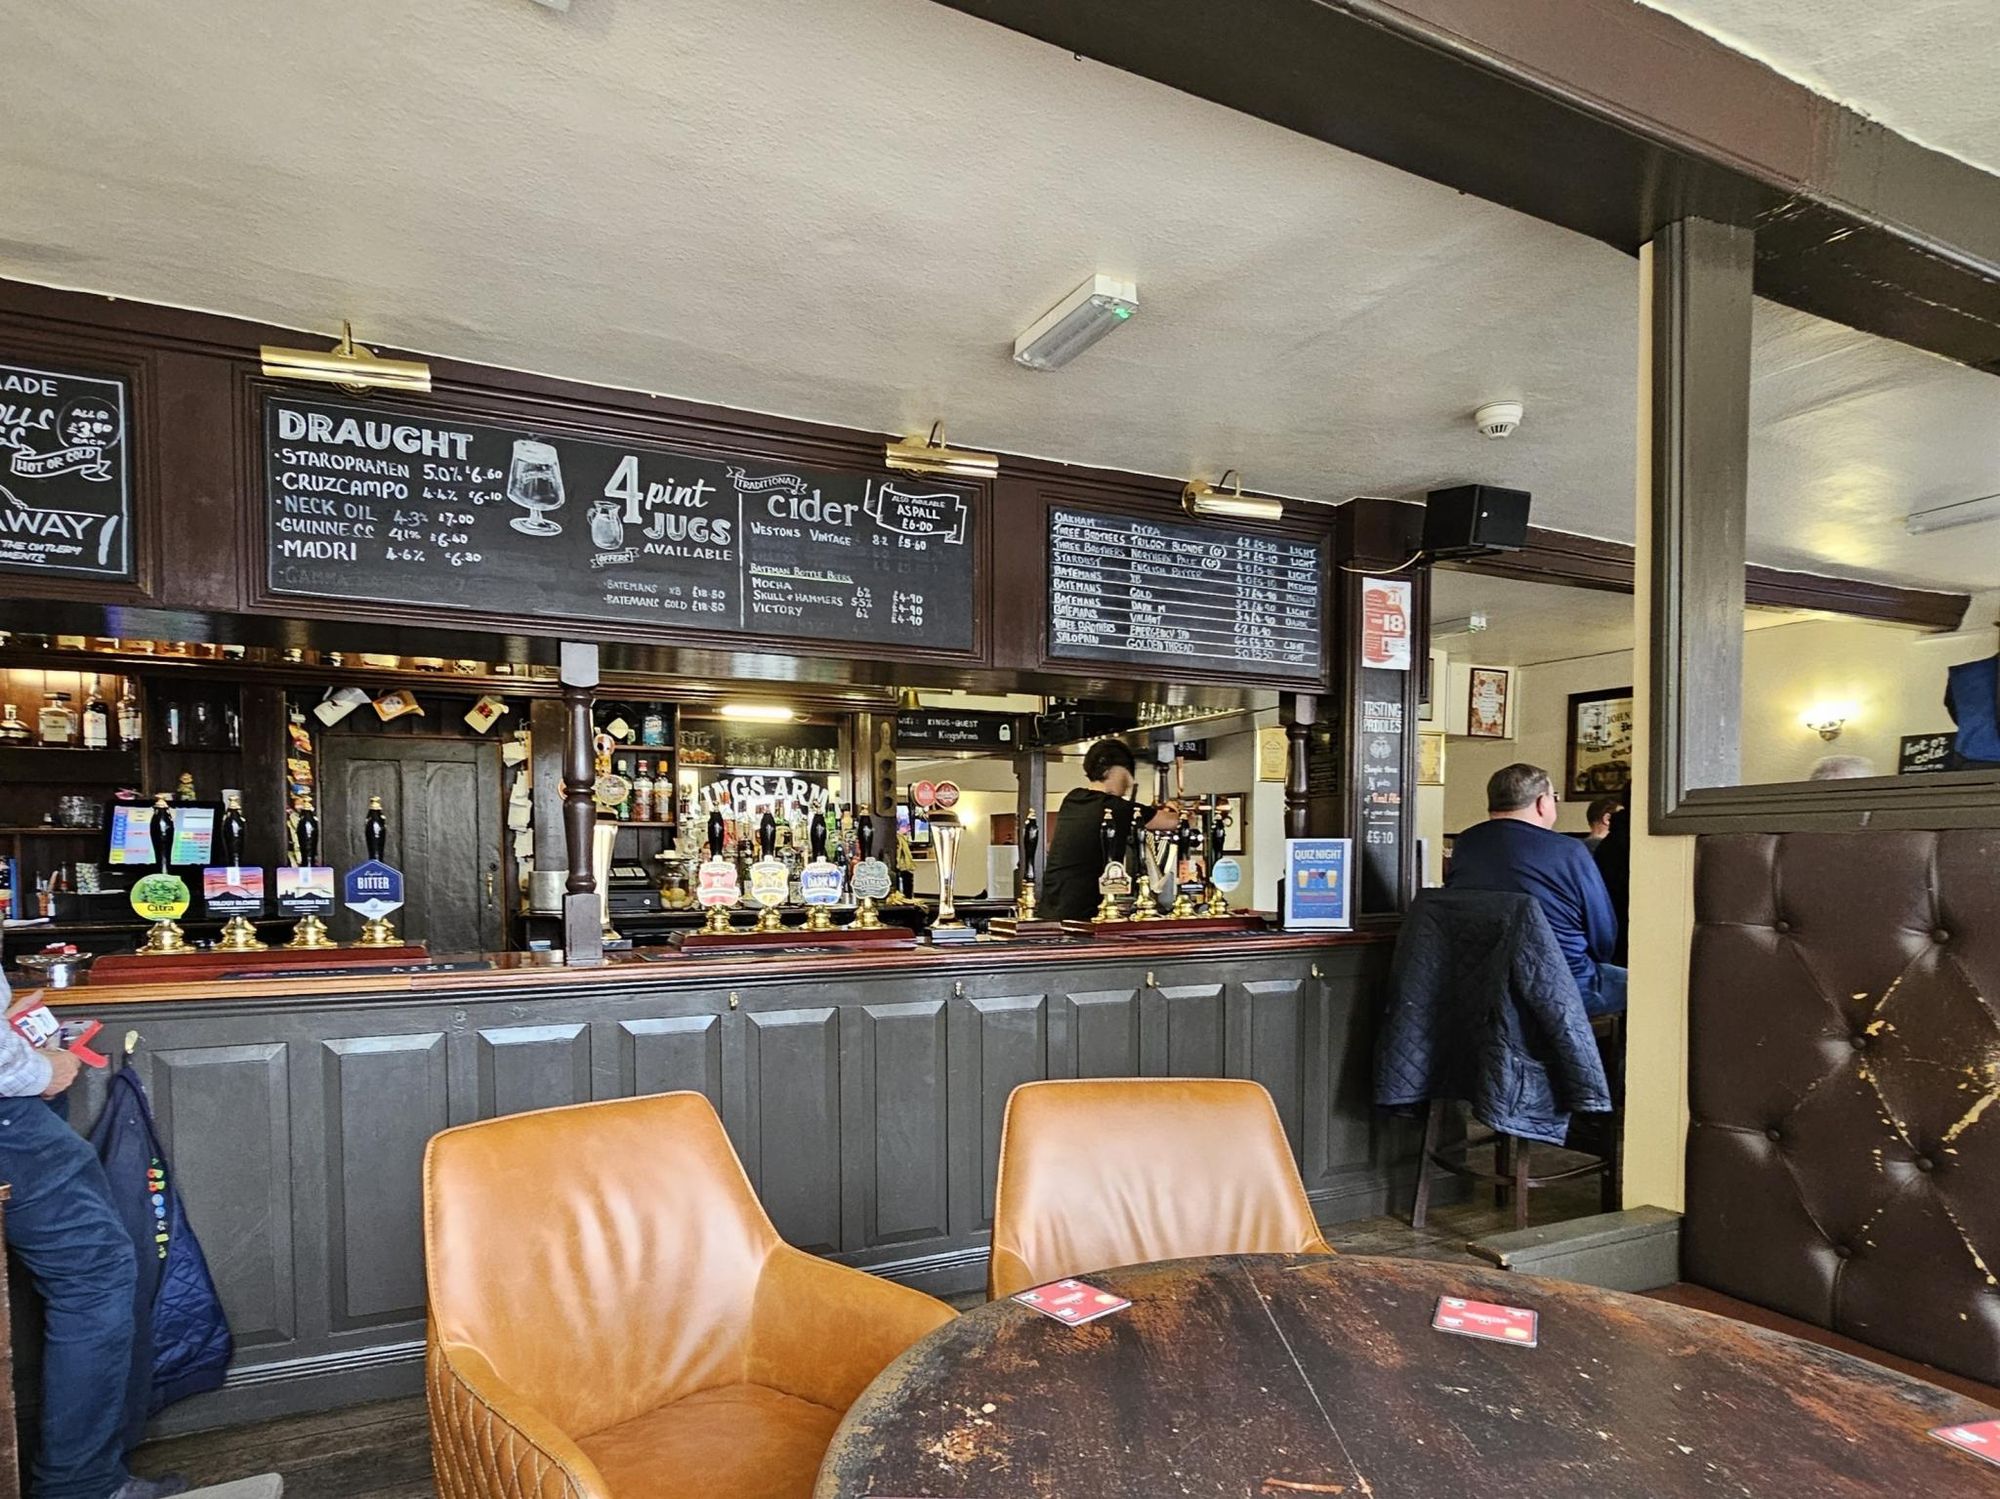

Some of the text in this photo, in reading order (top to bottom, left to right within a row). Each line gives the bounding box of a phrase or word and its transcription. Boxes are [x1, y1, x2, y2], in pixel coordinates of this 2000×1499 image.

[0, 375, 58, 397] ADE
[278, 409, 473, 460] DRAUGHT
[16, 449, 96, 473] HOT OR COLD
[281, 449, 410, 479] STAROPRAMEN
[282, 472, 409, 500] CRUZCAMPO
[604, 455, 717, 524] 4 pint
[285, 495, 337, 517] NECK
[344, 502, 378, 522] OIL
[767, 489, 859, 526] cider
[897, 504, 940, 520] ASPALL
[280, 517, 375, 540] GUINNESS
[643, 512, 732, 545] JUGS
[751, 522, 801, 538] WESTONS
[809, 529, 851, 546] VINTAGE
[284, 541, 357, 561] MADRI
[644, 543, 733, 561] AVAILABLE
[606, 579, 658, 594] BATEMANS
[752, 577, 792, 590] MOCHA
[606, 595, 659, 608] BATEMANS
[664, 600, 687, 610] GOLD
[753, 589, 785, 601] SKULL
[795, 593, 844, 607] HAMMERS
[752, 602, 803, 617] VICTORY
[1383, 614, 1404, 631] 18
[1363, 701, 1402, 717] TASTING
[1295, 848, 1342, 861] QUIZ NIGHT
[357, 876, 390, 890] BITTER
[147, 903, 175, 913] Citra
